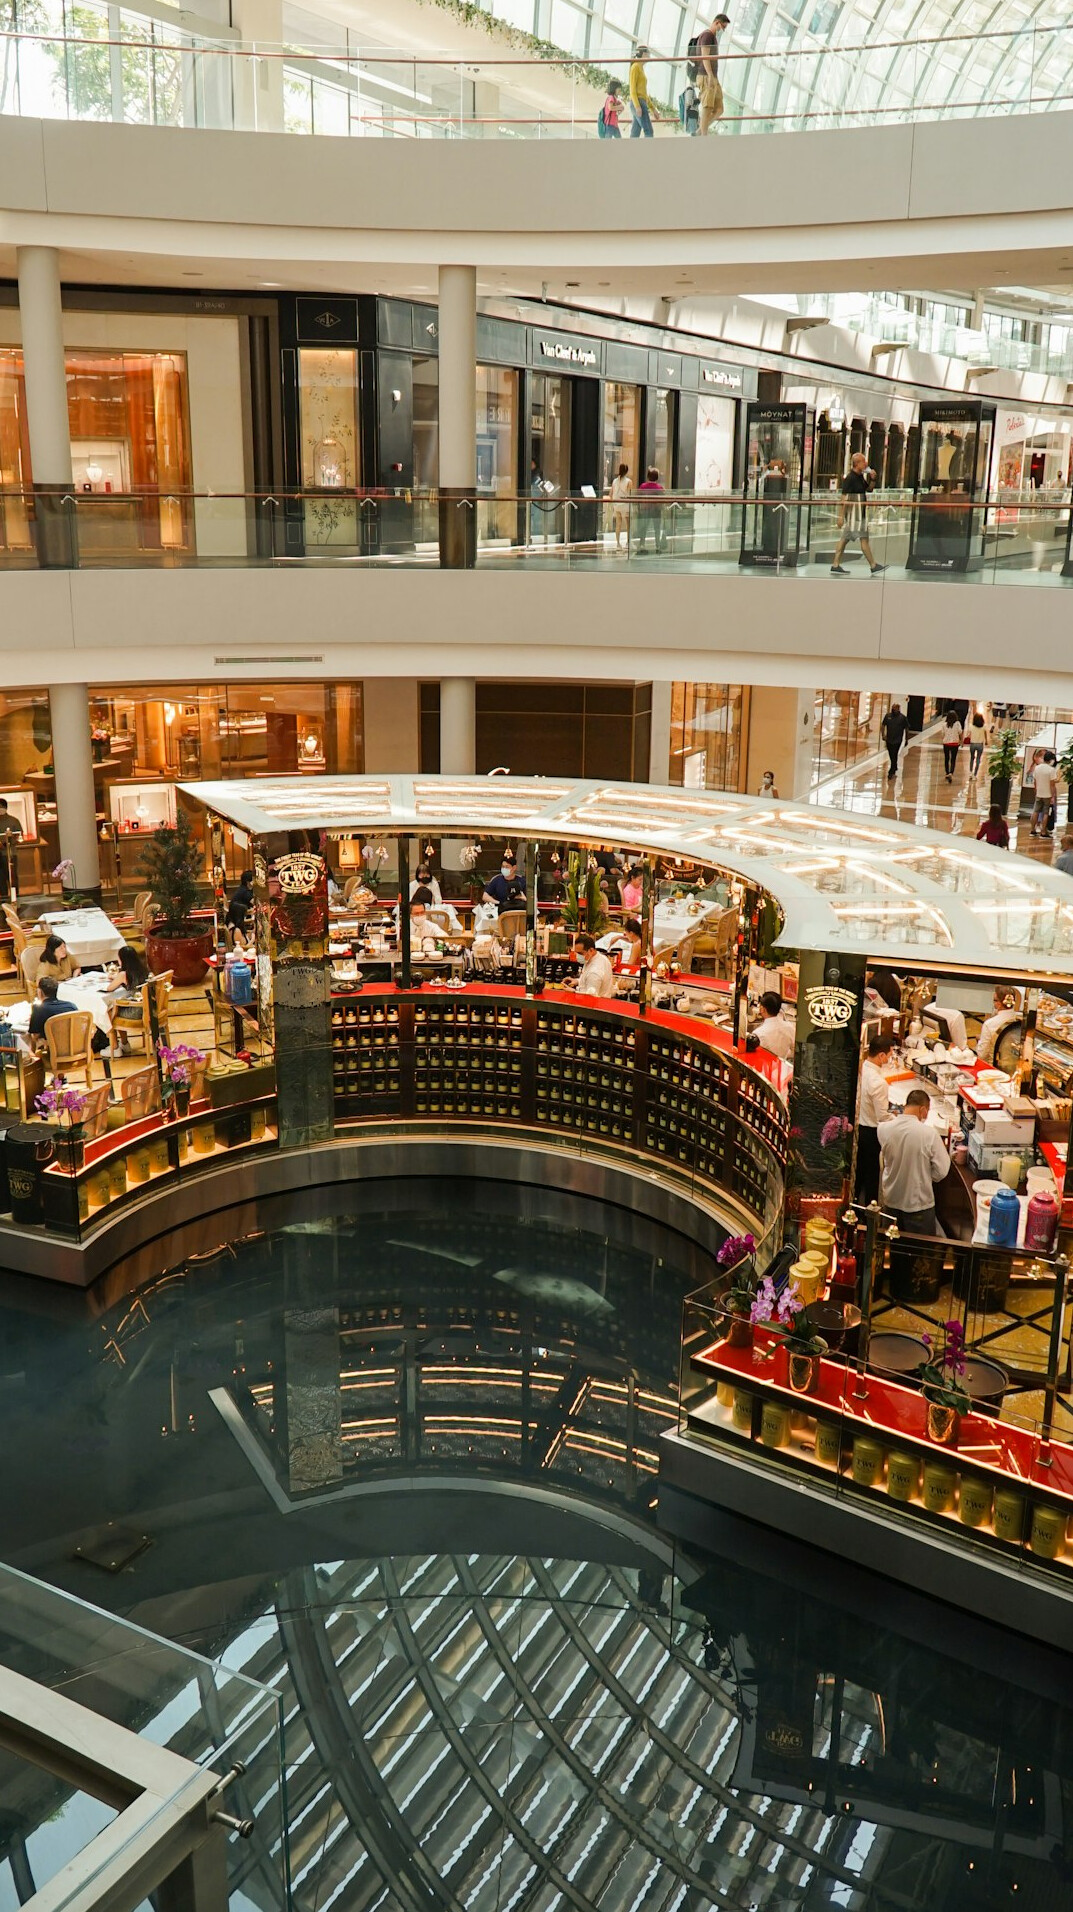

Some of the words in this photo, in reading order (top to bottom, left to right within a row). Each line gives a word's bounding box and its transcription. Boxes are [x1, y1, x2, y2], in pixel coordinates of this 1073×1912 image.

[540, 341, 555, 357] Van
[555, 344, 572, 360] Cleef
[577, 348, 596, 366] Arpels
[703, 369, 713, 382] Van
[281, 869, 316, 883] TWG
[811, 1003, 849, 1018] TWG
[857, 1458, 875, 1469] TWG
[892, 1472, 910, 1483] TWG
[930, 1485, 950, 1496] TWG
[965, 1499, 985, 1511] TWG
[1033, 1525, 1052, 1540] TWG
